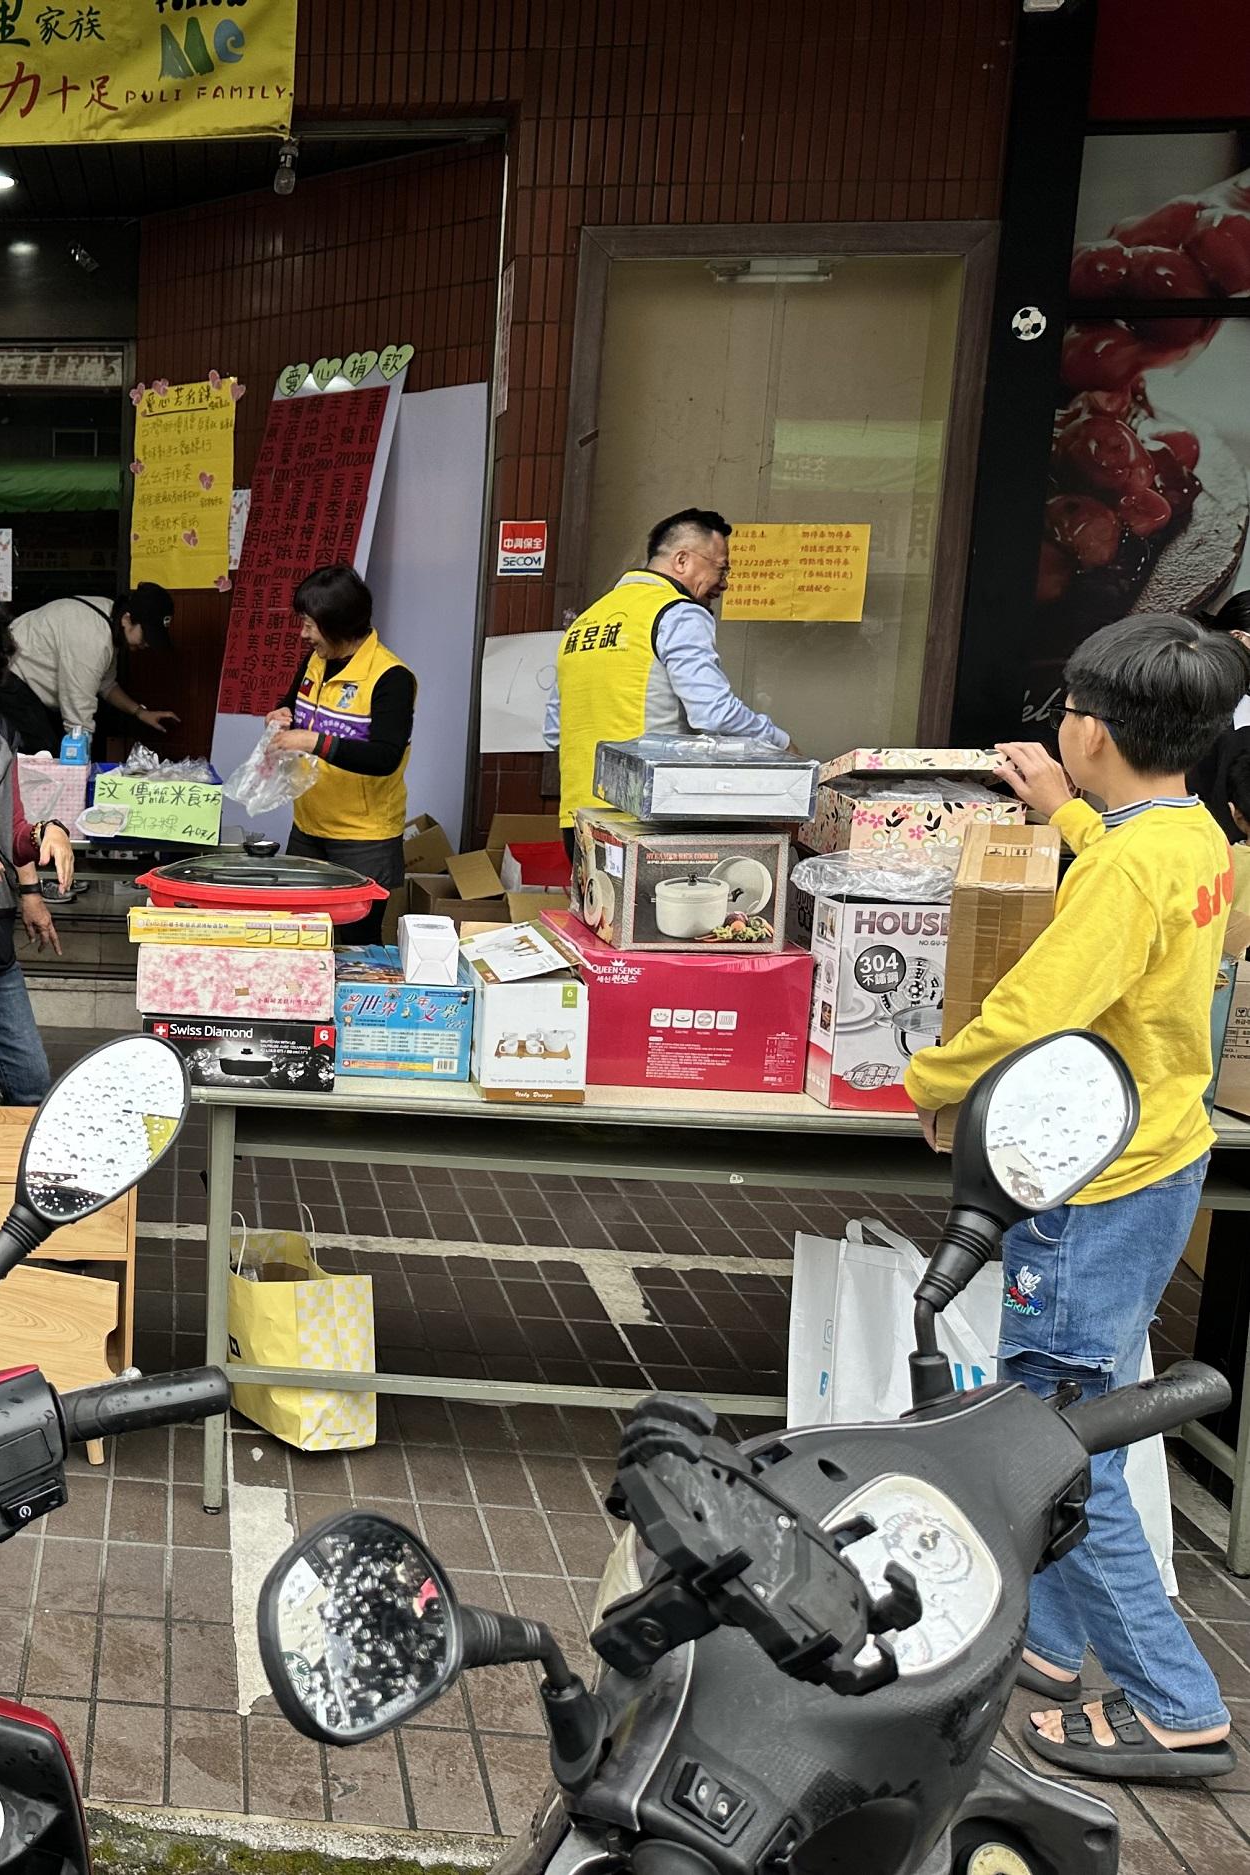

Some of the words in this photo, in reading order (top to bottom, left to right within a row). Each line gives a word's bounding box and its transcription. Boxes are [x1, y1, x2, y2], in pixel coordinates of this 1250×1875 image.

[125, 88, 182, 104] PULI
[502, 556, 542, 567] SECOM
[563, 621, 623, 656] 蘇昱誠
[859, 952, 899, 973] 304
[591, 964, 618, 975] QUEEN
[618, 966, 642, 976] SENSE
[567, 989, 574, 998] 6
[169, 1023, 202, 1036] Swiss
[204, 1025, 254, 1039] Diamond
[319, 1030, 329, 1041] 6
